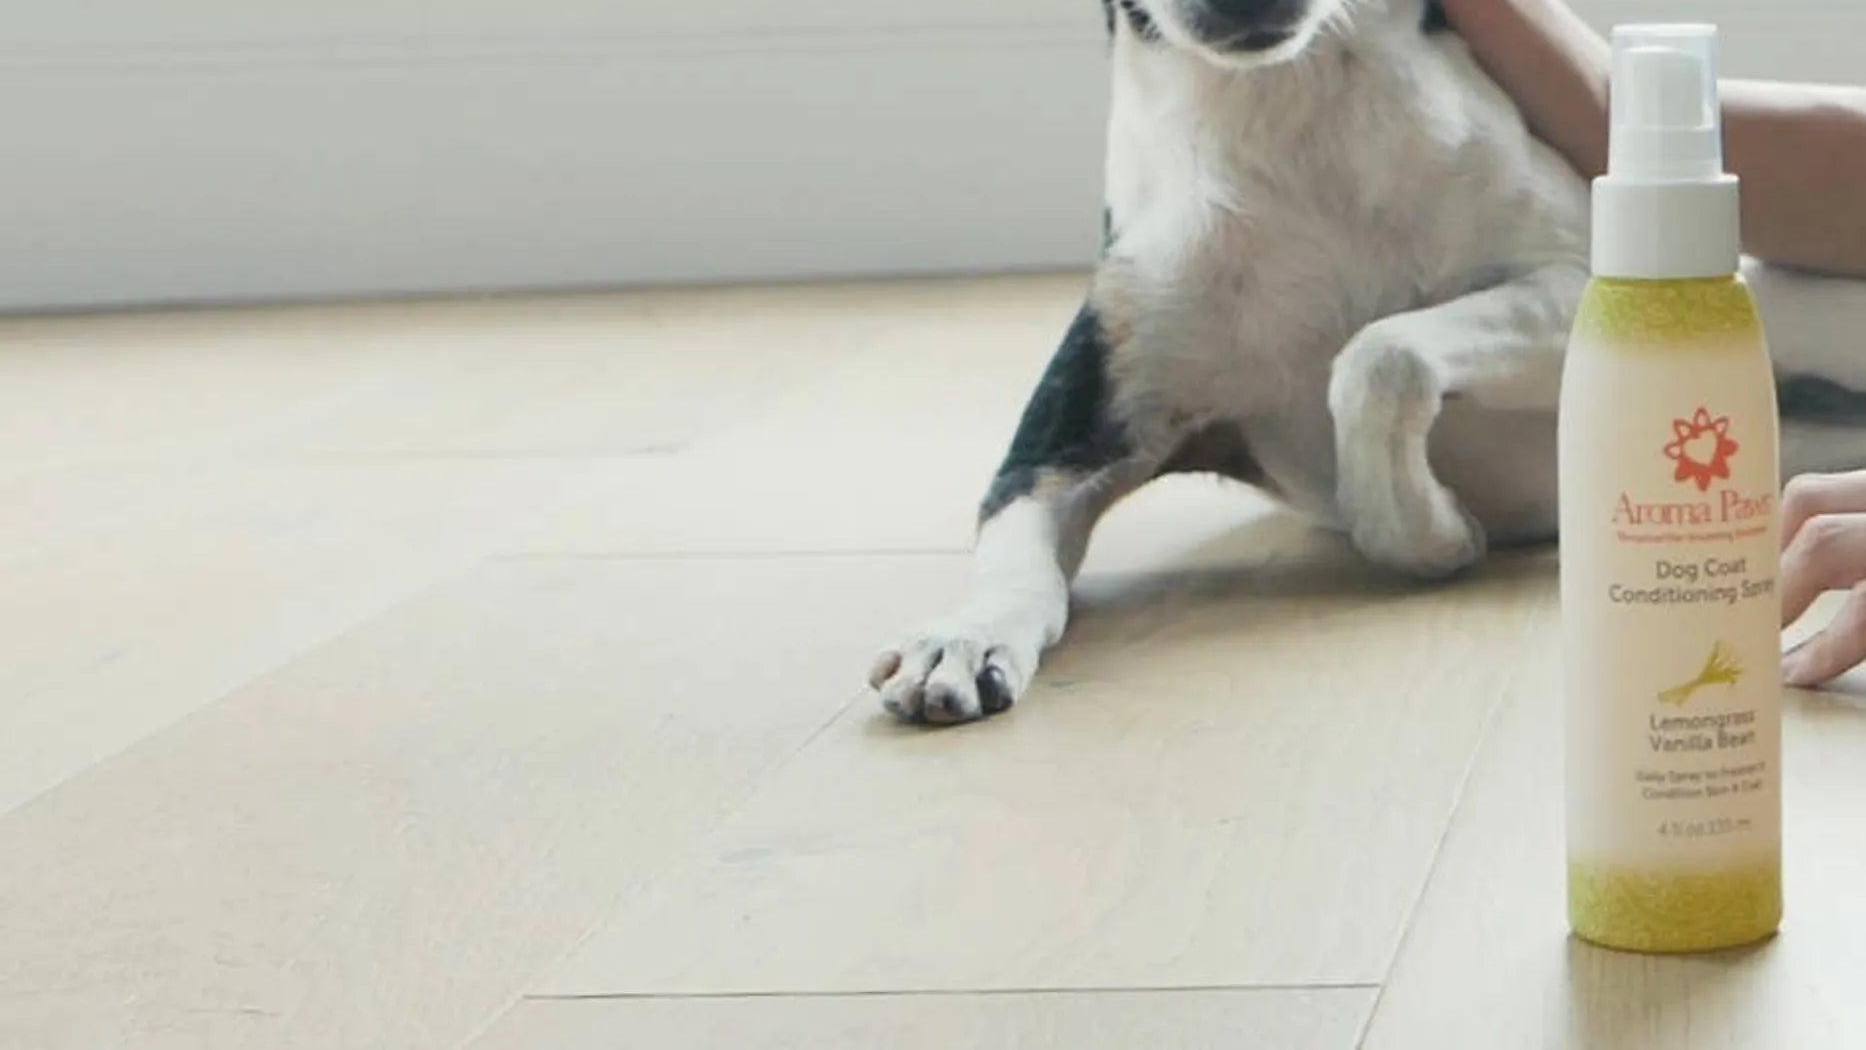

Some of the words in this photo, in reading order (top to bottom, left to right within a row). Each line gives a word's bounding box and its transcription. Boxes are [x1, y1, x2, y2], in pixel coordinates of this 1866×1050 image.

[1612, 491, 1711, 524] Aroma
[1656, 561, 1699, 582] Dog
[1704, 558, 1747, 577] Coat
[1608, 584, 1738, 605] Conditioning
[1649, 711, 1755, 731] Lemongrass
[1649, 734, 1713, 753] Vanilla
[1717, 730, 1756, 749] Bean
